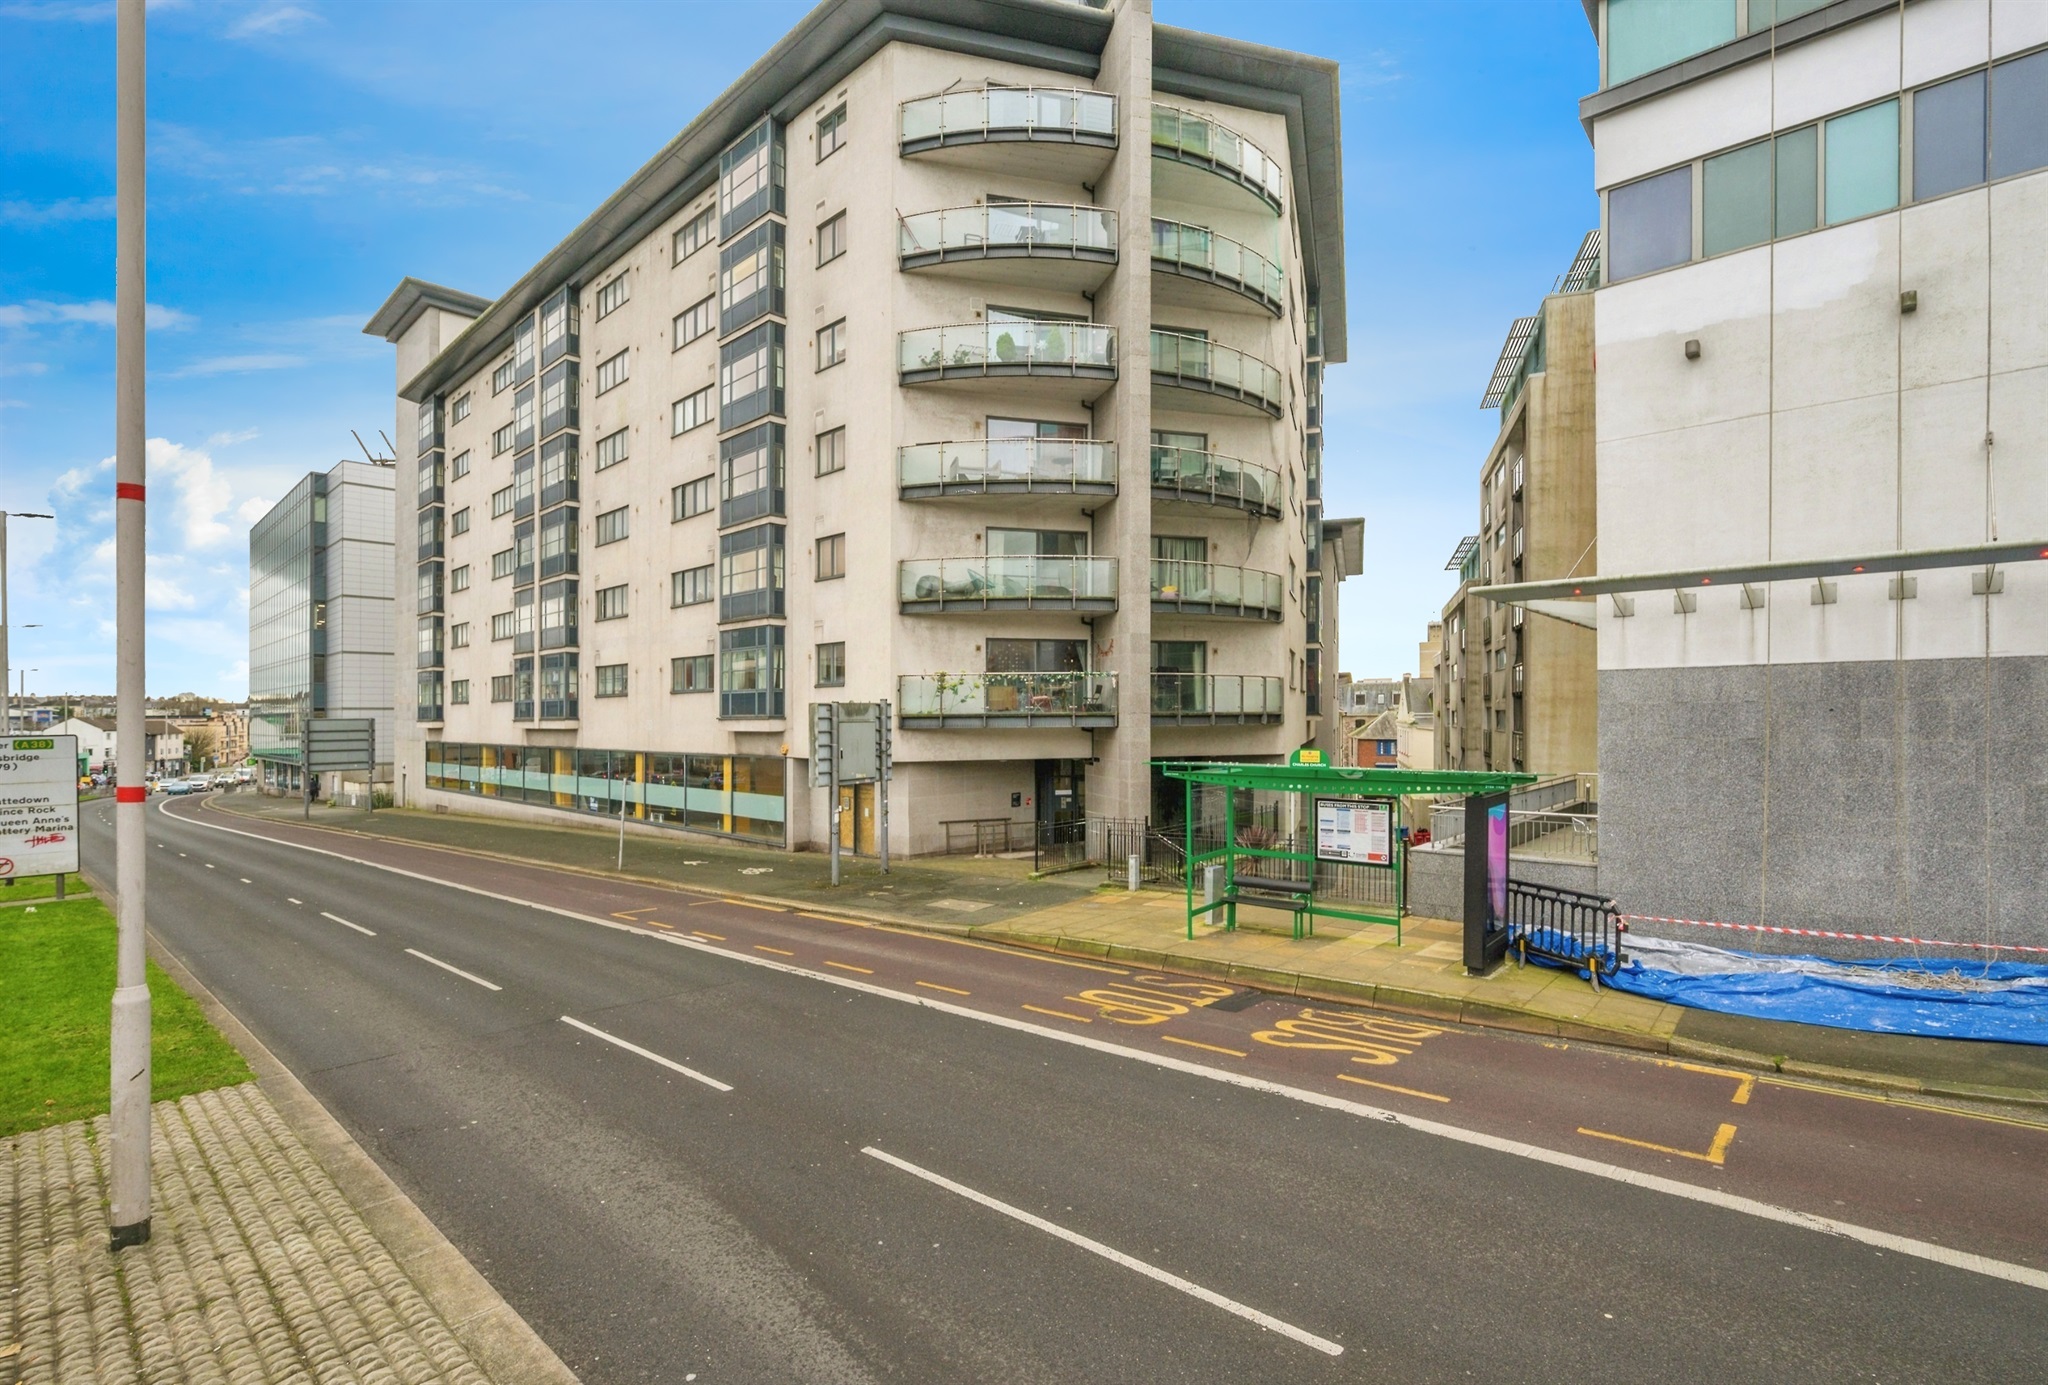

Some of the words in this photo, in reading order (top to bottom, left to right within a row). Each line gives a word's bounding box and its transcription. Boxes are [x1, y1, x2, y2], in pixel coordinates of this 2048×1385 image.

[0, 797, 49, 805] ttedown
[28, 806, 56, 814] Rock
[33, 815, 70, 824] Anne's
[0, 827, 31, 835] ttery
[35, 824, 74, 833] Marina
[1063, 975, 1235, 1026] STOP
[1251, 1007, 1444, 1065] BUS
